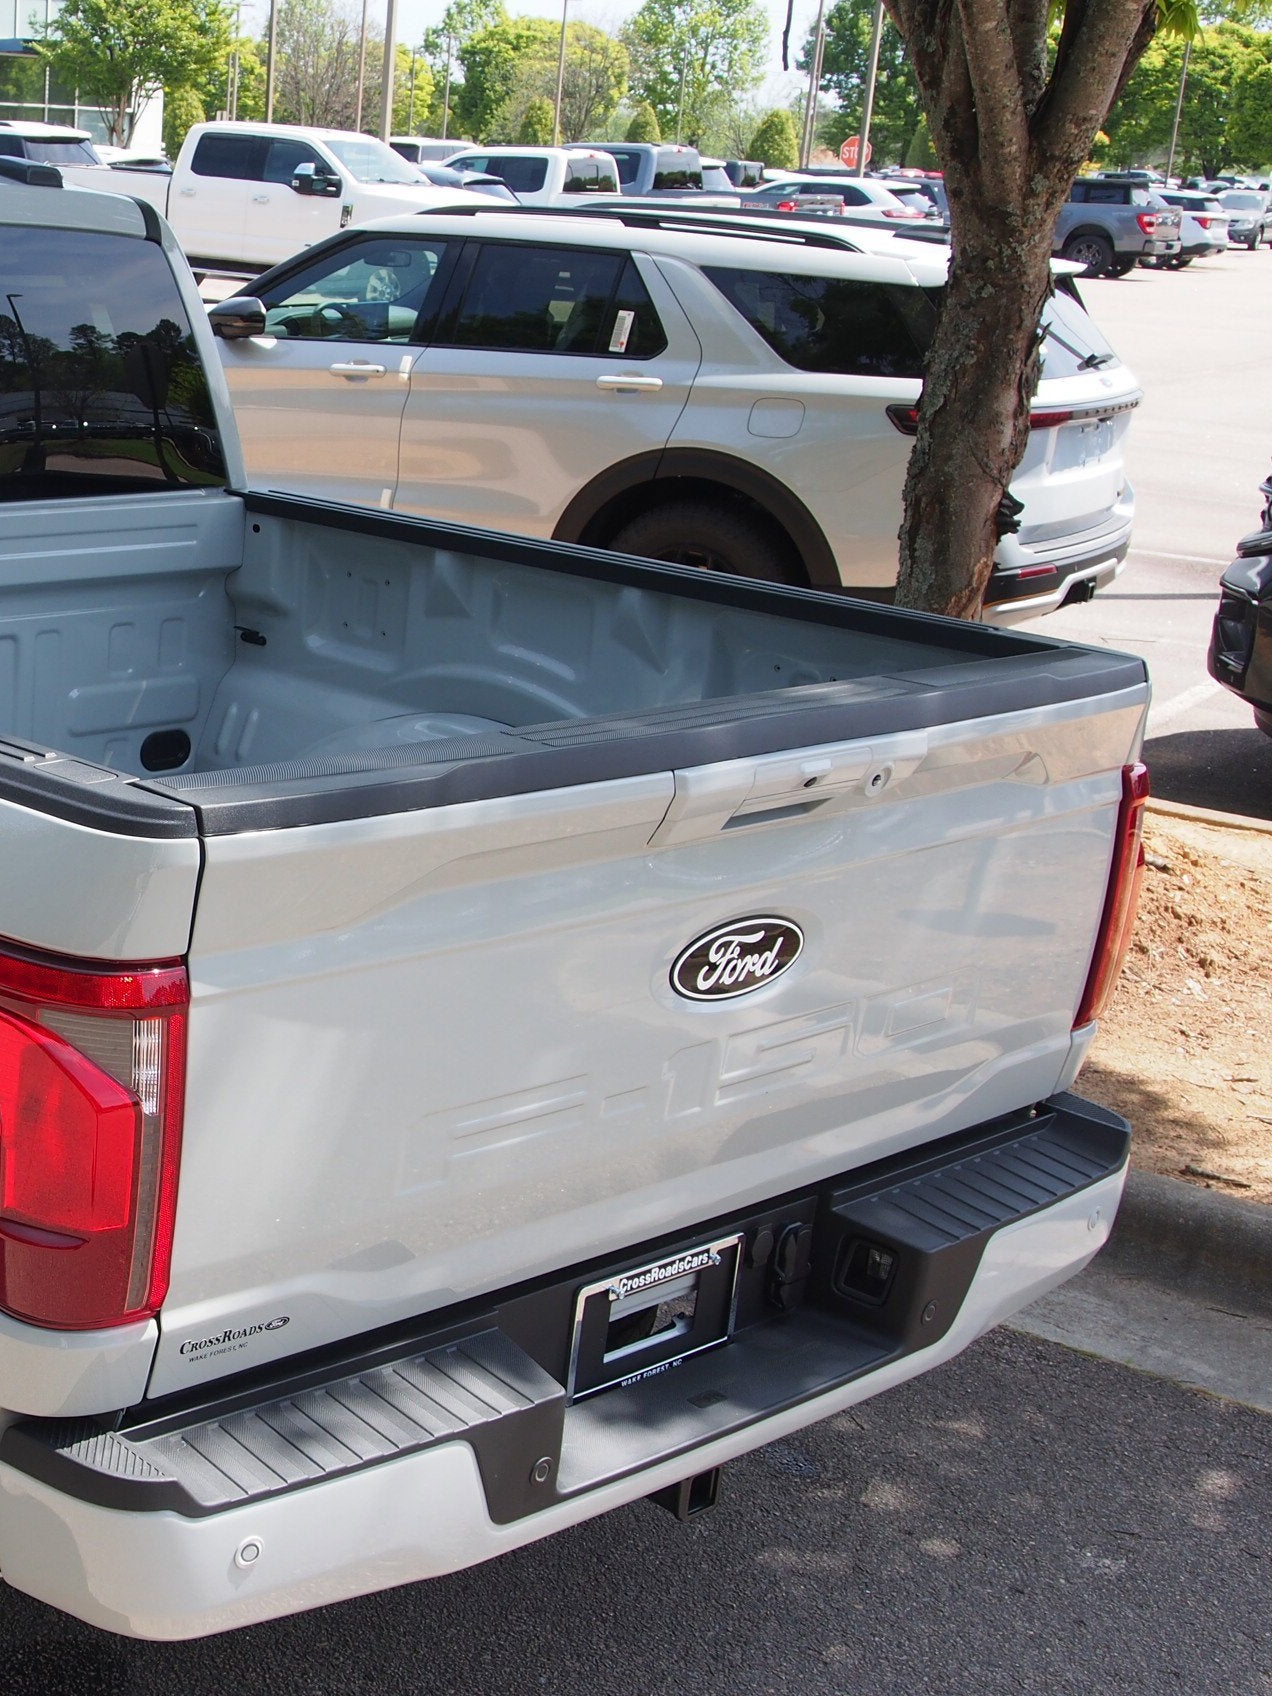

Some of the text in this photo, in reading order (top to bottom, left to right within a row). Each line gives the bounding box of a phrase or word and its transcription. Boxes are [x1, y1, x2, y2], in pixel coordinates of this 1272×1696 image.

[696, 930, 784, 991] Ford
[620, 1252, 709, 1293] CrossRoadsCars
[189, 1353, 208, 1363] WAKE
[238, 1341, 249, 1349] NC
[621, 1374, 641, 1387] WAKE
[672, 1358, 683, 1367] NC
